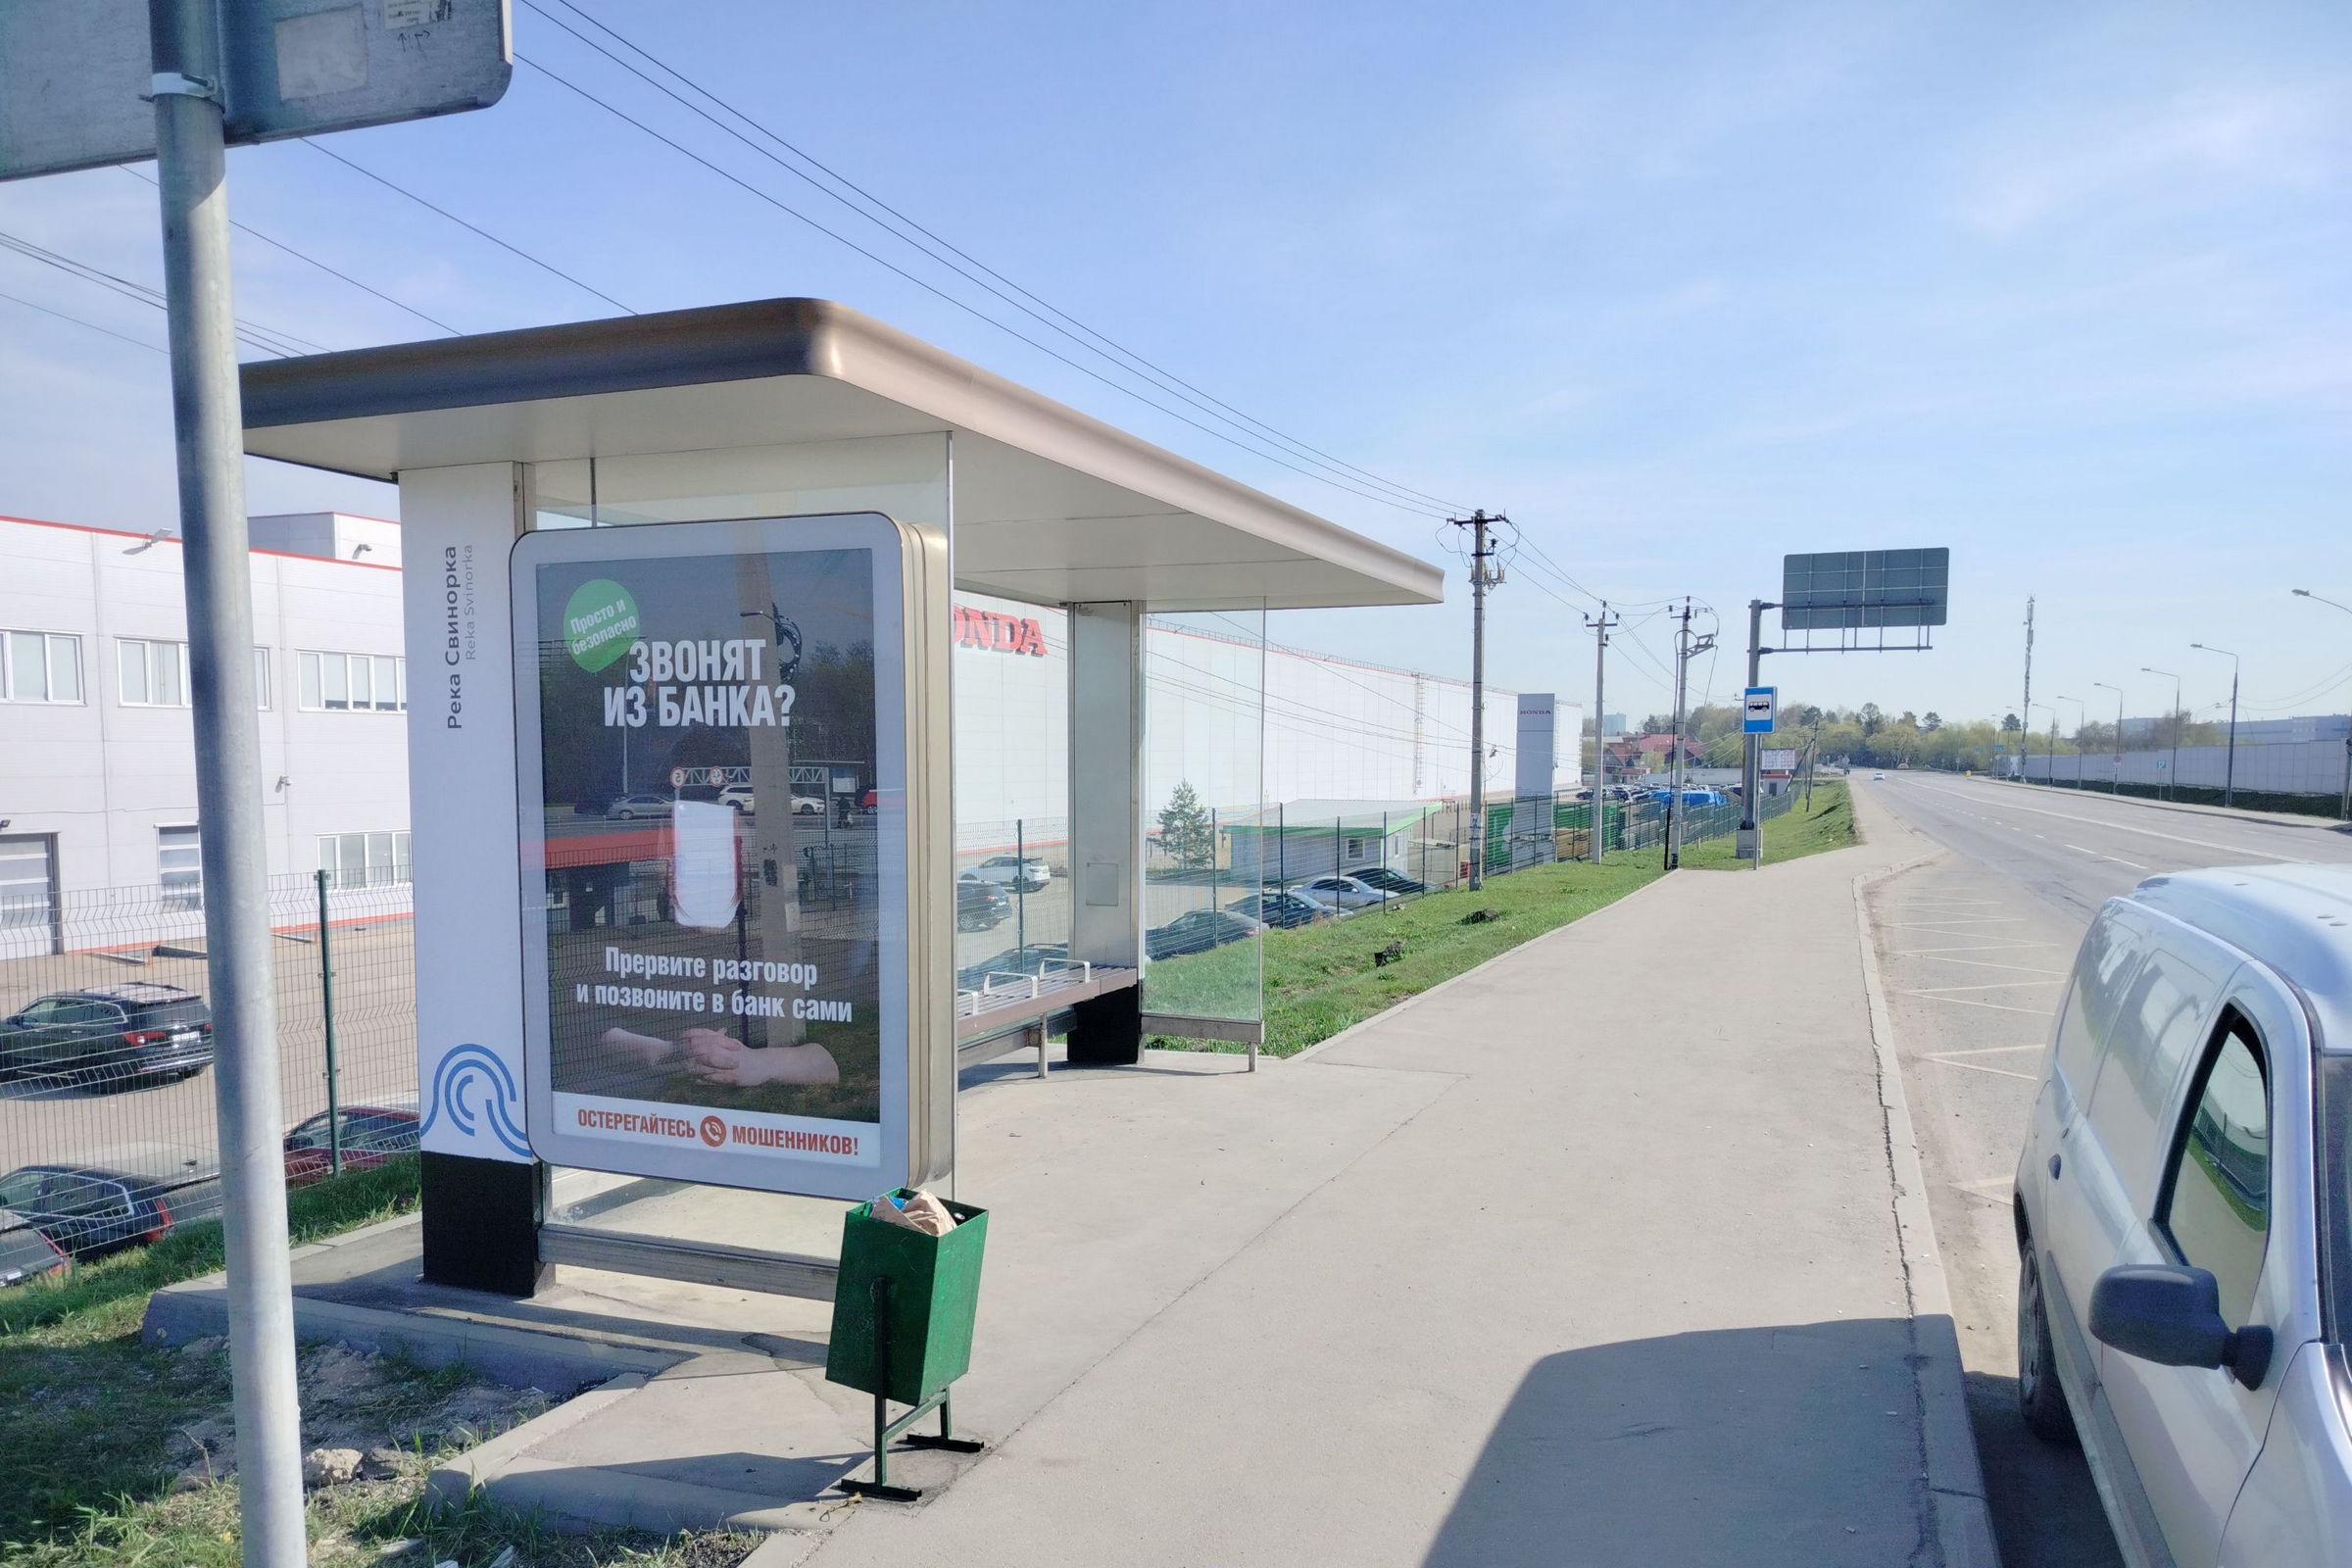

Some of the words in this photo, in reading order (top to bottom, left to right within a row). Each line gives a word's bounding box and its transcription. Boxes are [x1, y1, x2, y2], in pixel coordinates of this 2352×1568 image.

[462, 544, 475, 616] Svinorka
[445, 546, 462, 666] Свинорка
[569, 604, 615, 636] Просто
[465, 620, 476, 661] Reka
[571, 615, 637, 656] безопасно
[629, 638, 766, 683] ЗВОНЯТ
[447, 673, 463, 729] Река
[604, 686, 648, 728] ИЗ
[659, 684, 796, 728] БАНКА?
[605, 946, 706, 980] Прервите
[712, 957, 817, 991] разговор
[576, 983, 588, 1004] и
[595, 985, 706, 1012] позвоните
[712, 993, 724, 1013] в
[731, 989, 785, 1018] банк
[792, 997, 853, 1022] сами
[577, 1108, 696, 1139] ОСТЕРЕГАЙТЕСЬ
[732, 1125, 859, 1156] МОШЕННИКОВ!
